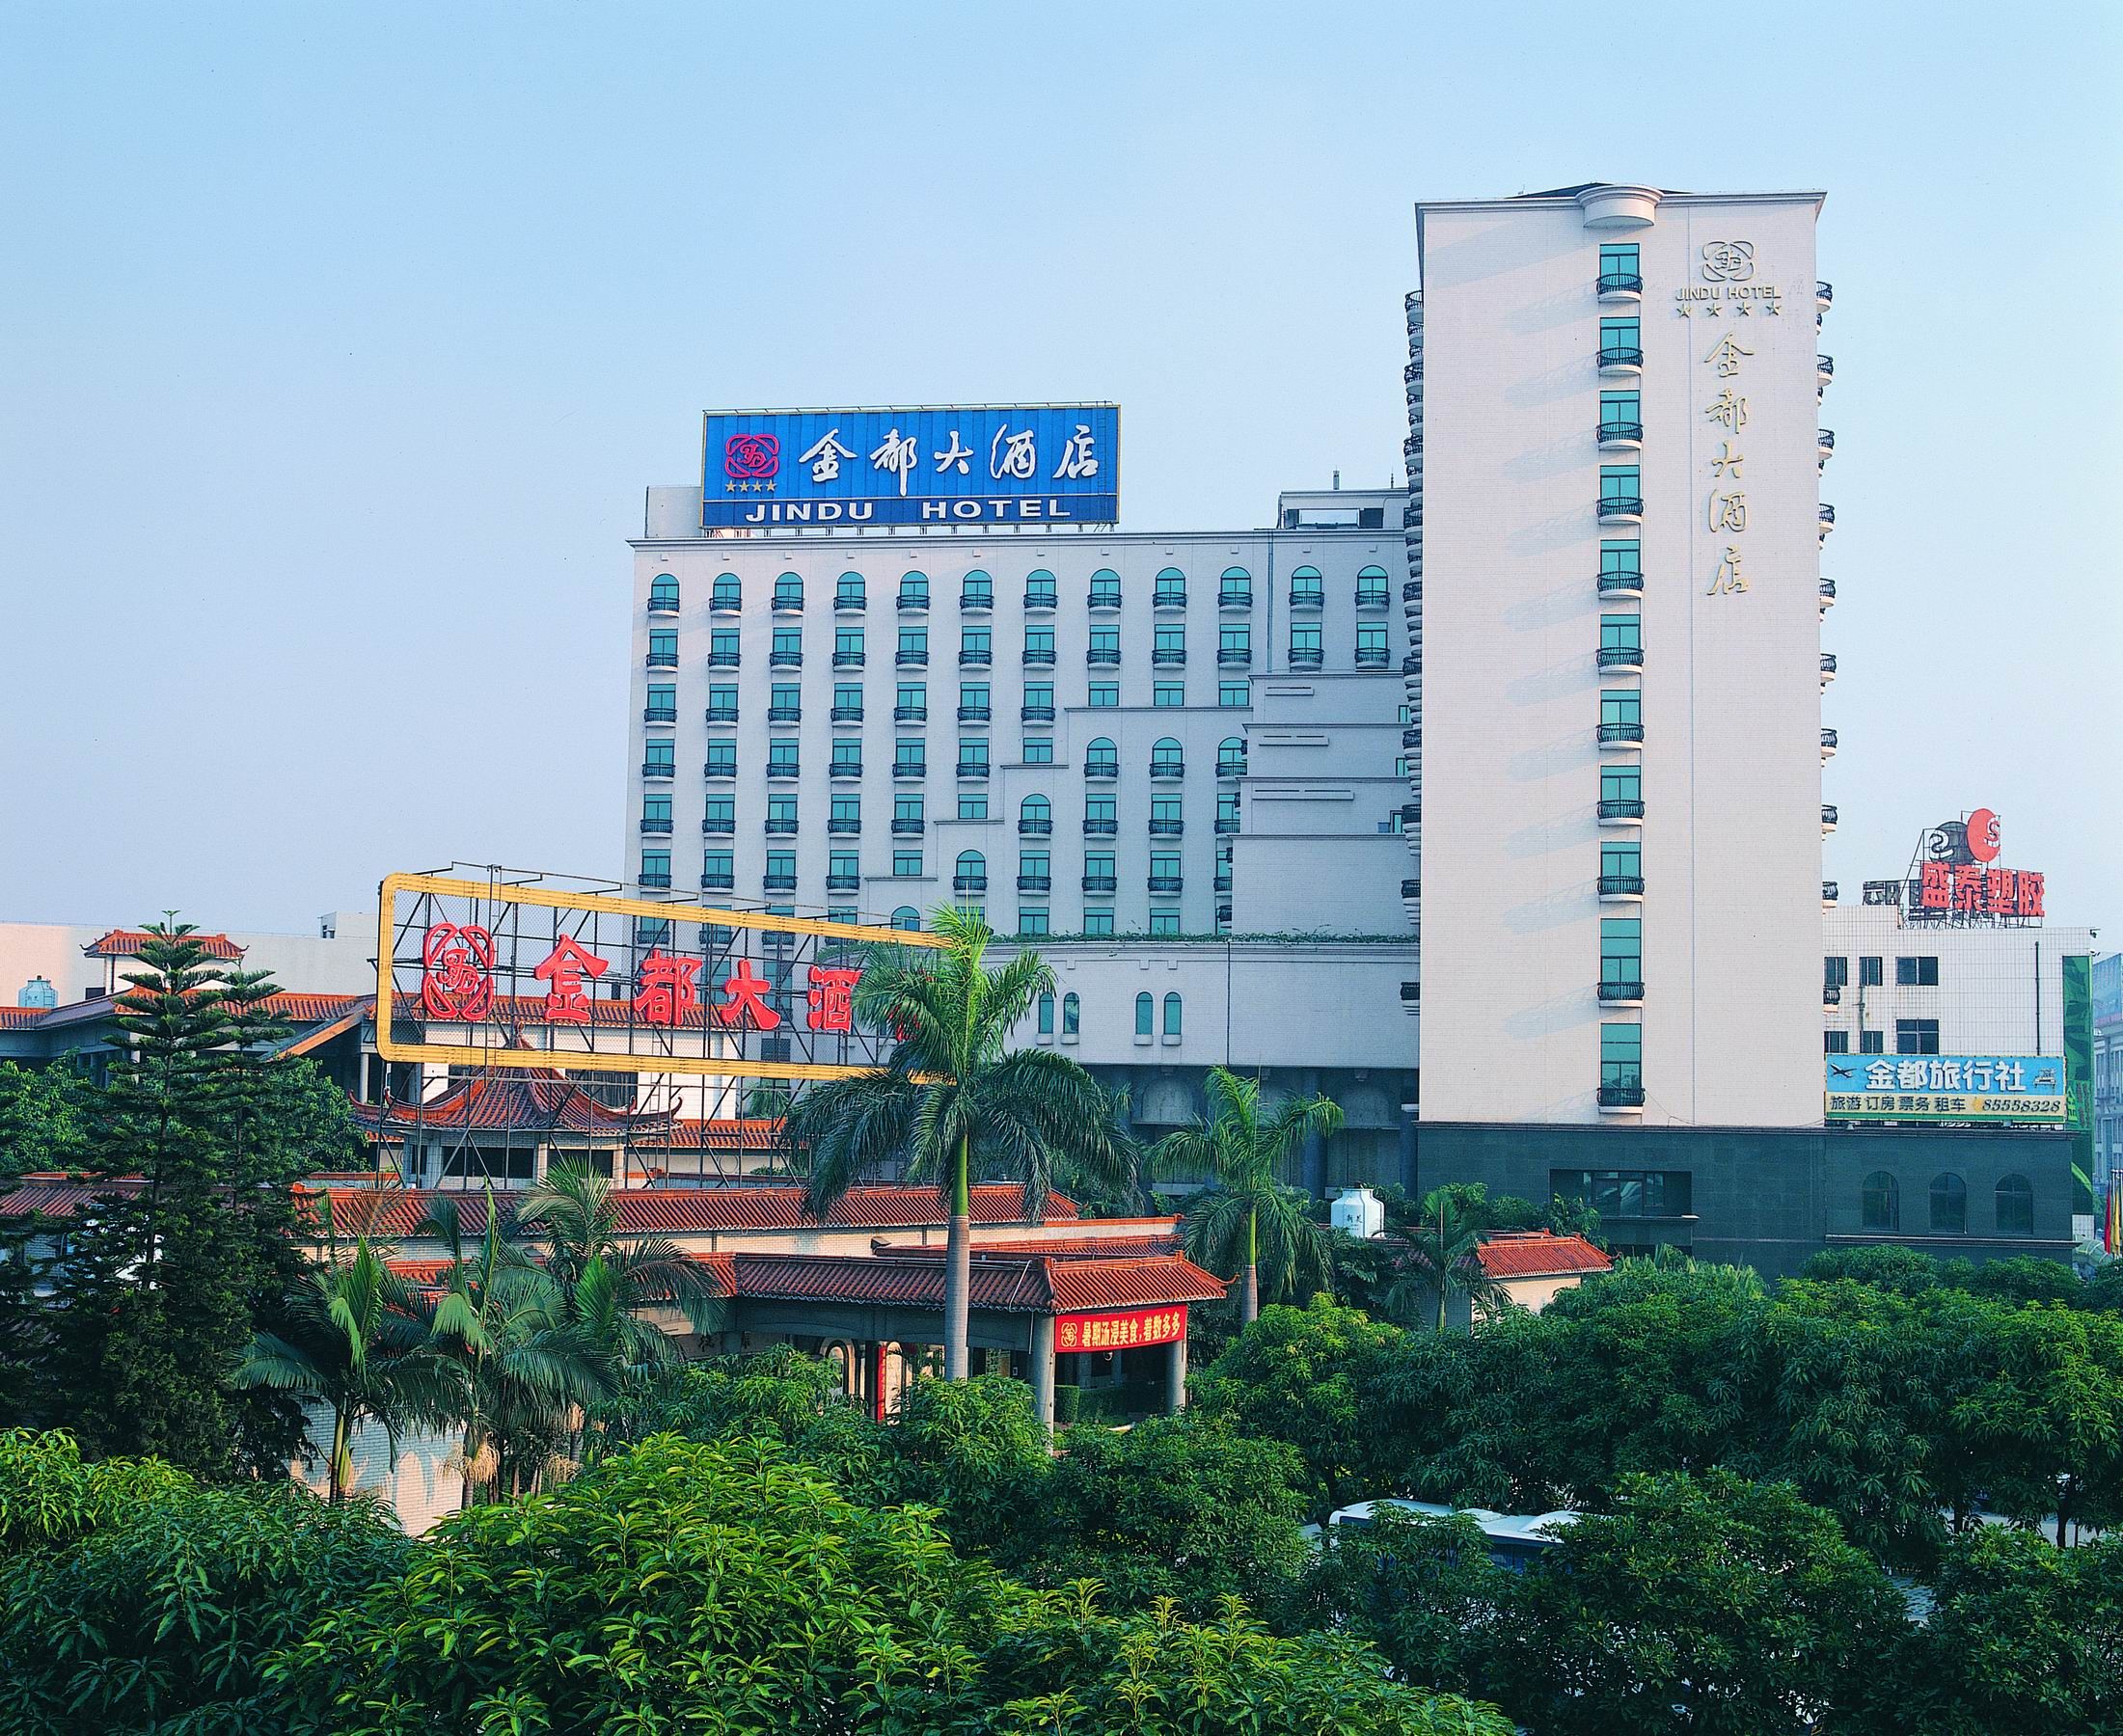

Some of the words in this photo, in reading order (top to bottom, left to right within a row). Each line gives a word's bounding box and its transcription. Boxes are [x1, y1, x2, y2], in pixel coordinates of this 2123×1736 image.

[1675, 286, 1722, 301] JINDU
[1728, 285, 1782, 300] HOTEL
[799, 422, 1100, 497] 金都大酒店
[1703, 331, 1755, 596] 金都大酒店
[746, 502, 874, 522] JINDU
[921, 500, 1071, 518] HOTEL
[1921, 862, 2045, 917] 盛泰塑胶
[534, 934, 921, 1043] 金都大酒
[1864, 1059, 2027, 1091] 金都旅行社
[1830, 1096, 1862, 1110] 旅游
[1865, 1096, 1895, 1111] 订房
[1898, 1096, 1930, 1111] 票务
[1934, 1097, 1966, 1112] 租车
[1982, 1099, 2060, 1112] 85558328
